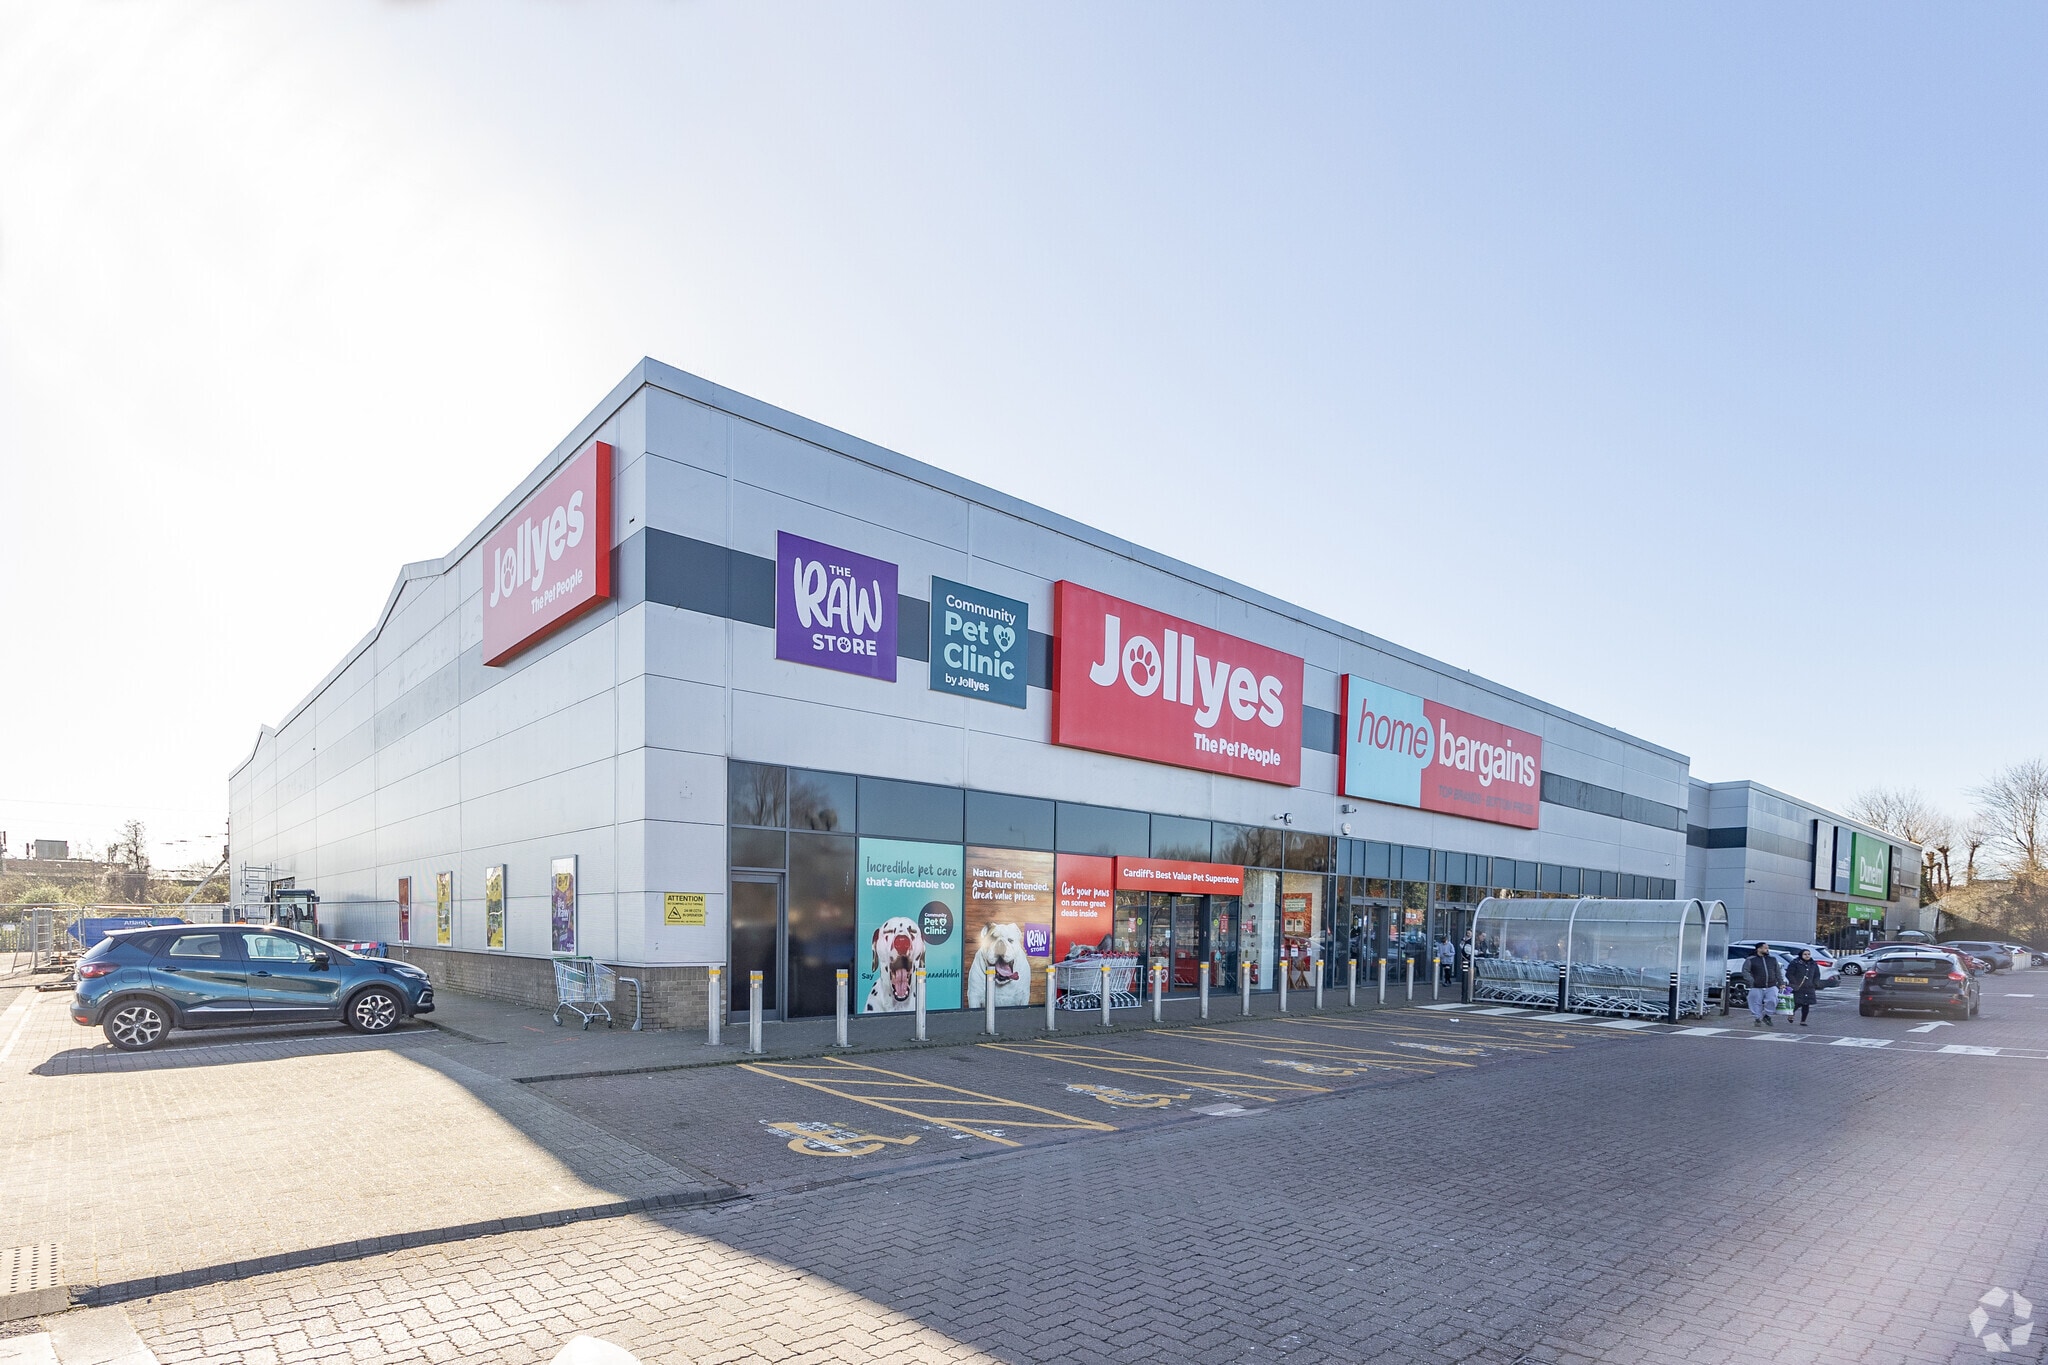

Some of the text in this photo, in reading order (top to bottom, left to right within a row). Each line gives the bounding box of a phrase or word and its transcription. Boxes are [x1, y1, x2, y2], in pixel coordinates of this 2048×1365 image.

[490, 490, 584, 608] Jollyes
[829, 565, 851, 577] THE
[531, 568, 583, 614] The Pet People
[794, 558, 882, 635] RAW
[946, 595, 1016, 626] Community
[945, 610, 989, 645] Pet
[813, 633, 877, 656] STORE
[944, 642, 1015, 680] Clinic
[1089, 613, 1284, 728] Jollyes
[945, 673, 990, 692] by Jollyes
[1193, 733, 1280, 766] The Pet People
[1358, 698, 1535, 787] home bargains
[866, 856, 958, 877] Incredible pet care
[972, 868, 1024, 879] Natural food.
[1123, 868, 1240, 884] Cardiff's Best Value Pet Superstore
[866, 877, 955, 890] that's affordable too
[972, 879, 1050, 891] As Nature intended.
[1061, 881, 1110, 899] Get your paws
[972, 887, 1036, 903] Great value prices.
[1089, 900, 1106, 909] great
[924, 918, 939, 926] Pet
[1061, 908, 1098, 918] deals inside
[924, 926, 947, 935] Clinic
[1026, 929, 1047, 948] RAW
